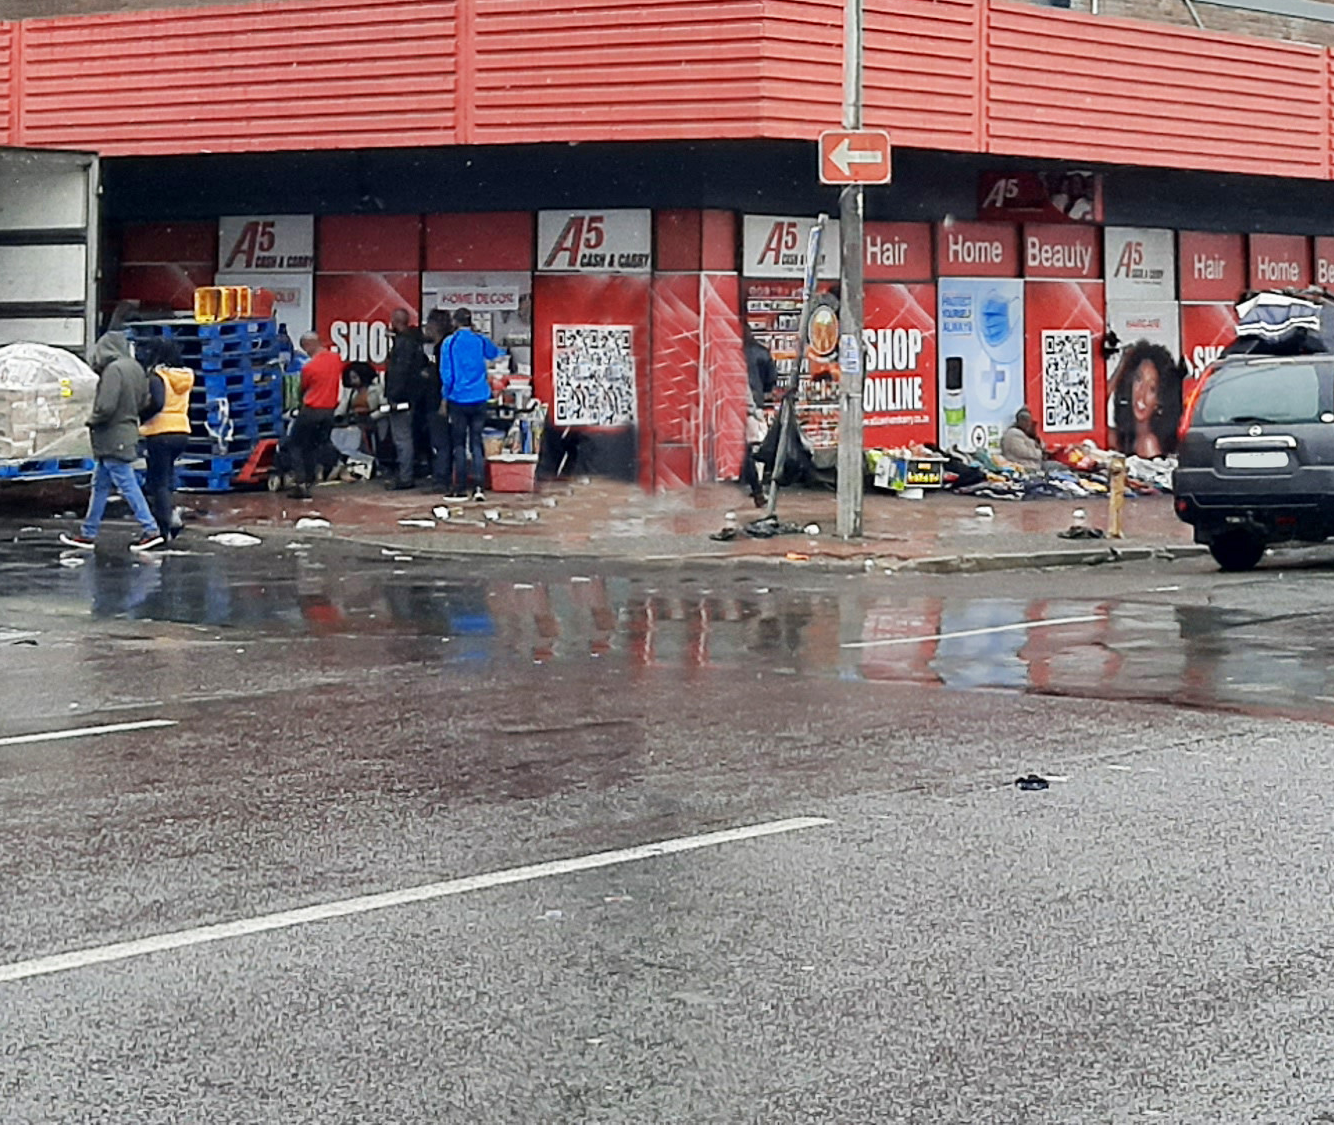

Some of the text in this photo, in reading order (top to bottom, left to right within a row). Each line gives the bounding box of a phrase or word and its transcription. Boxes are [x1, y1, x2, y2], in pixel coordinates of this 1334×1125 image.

[982, 178, 1019, 208] A5
[225, 221, 275, 268] A5
[543, 215, 604, 267] A5
[757, 221, 798, 265] A5
[866, 236, 907, 266] Hair
[948, 234, 1003, 263] Home
[1027, 237, 1092, 275] Beauty
[1114, 241, 1143, 278] A5
[1194, 254, 1226, 279] Hair
[1257, 256, 1299, 281] Home
[330, 321, 394, 364] SHO
[862, 328, 922, 371] SHOP
[863, 376, 923, 412] ONLINE
